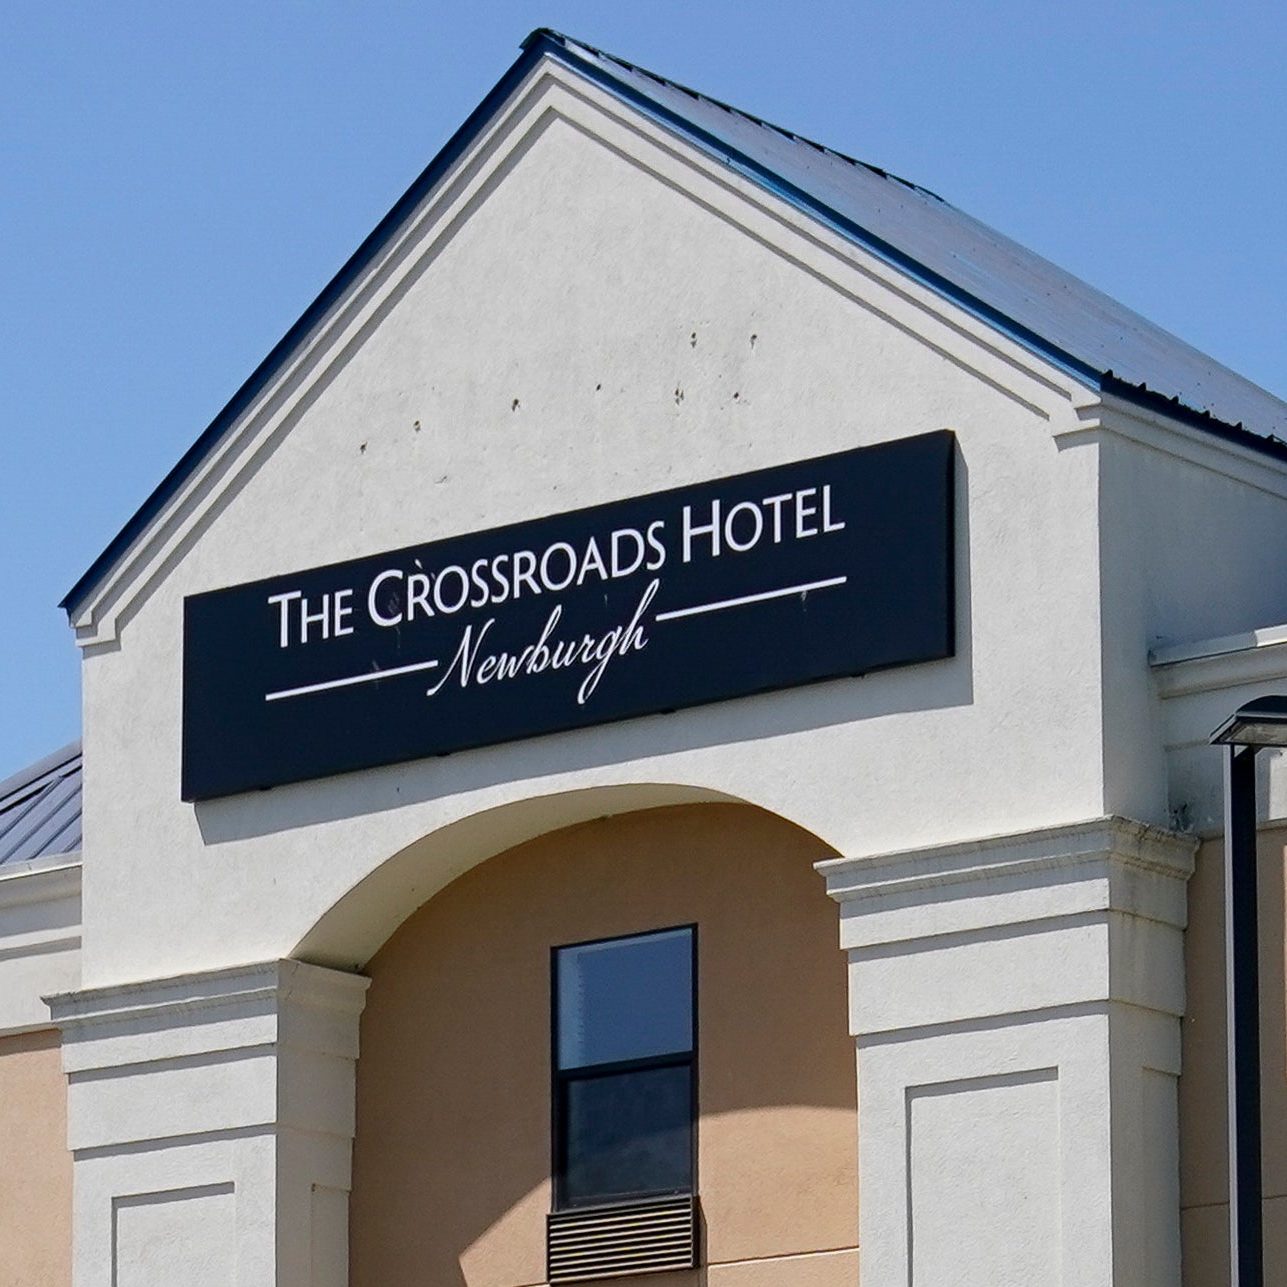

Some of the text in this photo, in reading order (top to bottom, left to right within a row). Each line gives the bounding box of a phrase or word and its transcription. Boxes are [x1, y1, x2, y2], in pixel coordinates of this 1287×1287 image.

[267, 484, 846, 648] THE CROSSROADS HOTEL
[426, 578, 660, 705] Newburgh
